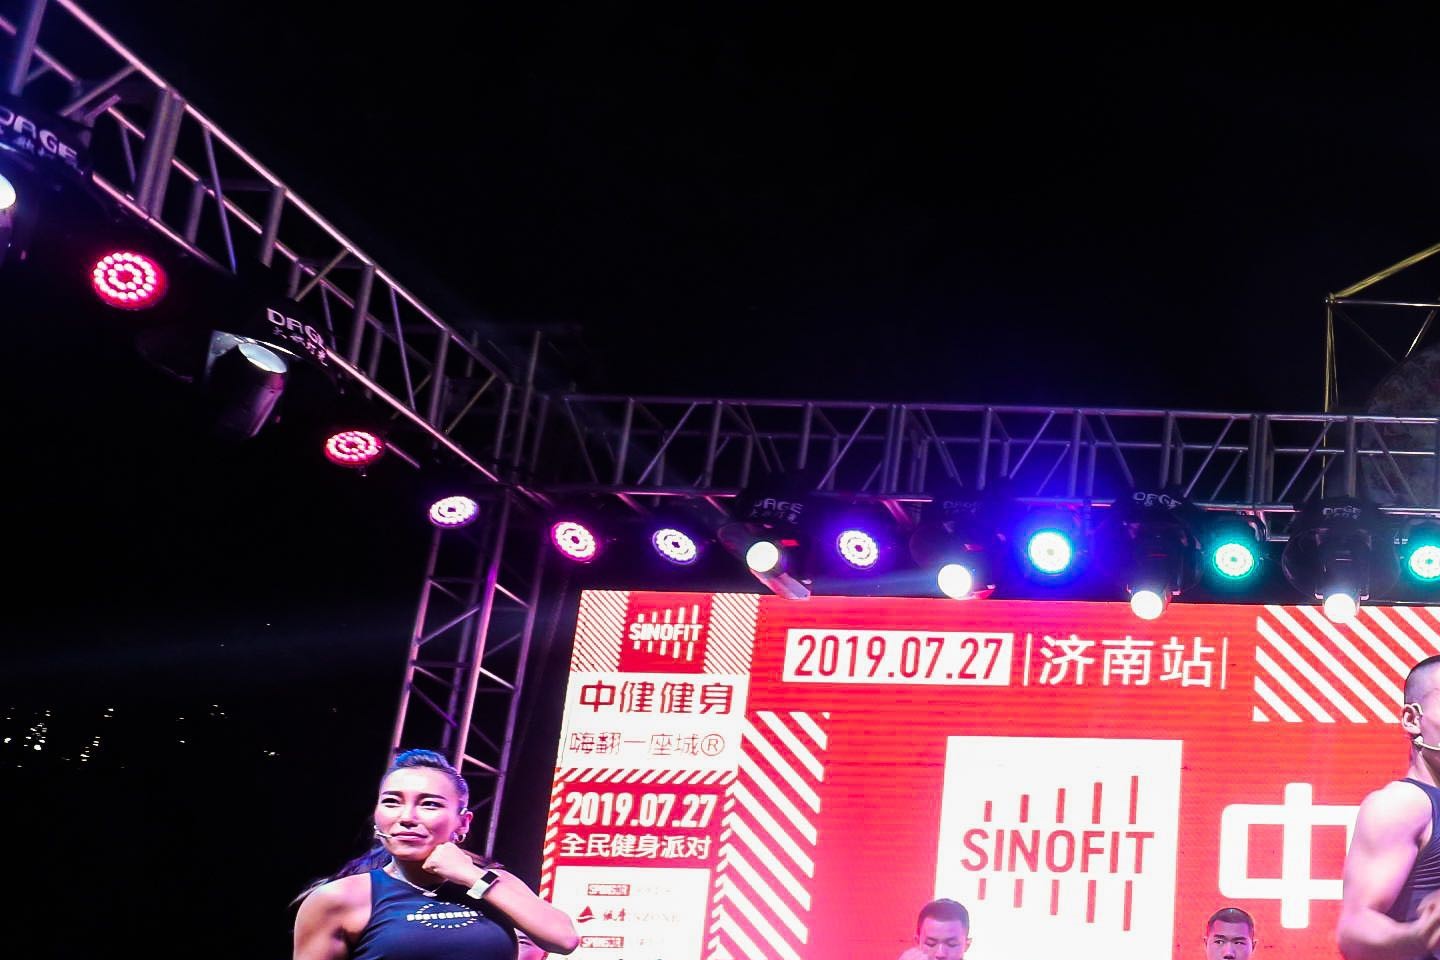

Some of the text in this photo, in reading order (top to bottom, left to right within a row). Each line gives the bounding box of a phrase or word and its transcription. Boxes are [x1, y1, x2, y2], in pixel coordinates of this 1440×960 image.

[266, 307, 324, 346] DAG
[629, 622, 703, 642] SINOFIT
[794, 634, 1003, 681] 2019.07.27
[1039, 633, 1217, 689] 济南站
[578, 679, 735, 716] 中健健身
[562, 791, 719, 829] 2019.07.27
[559, 832, 713, 860] 全民健身派对
[960, 828, 1155, 876] SINOFIT
